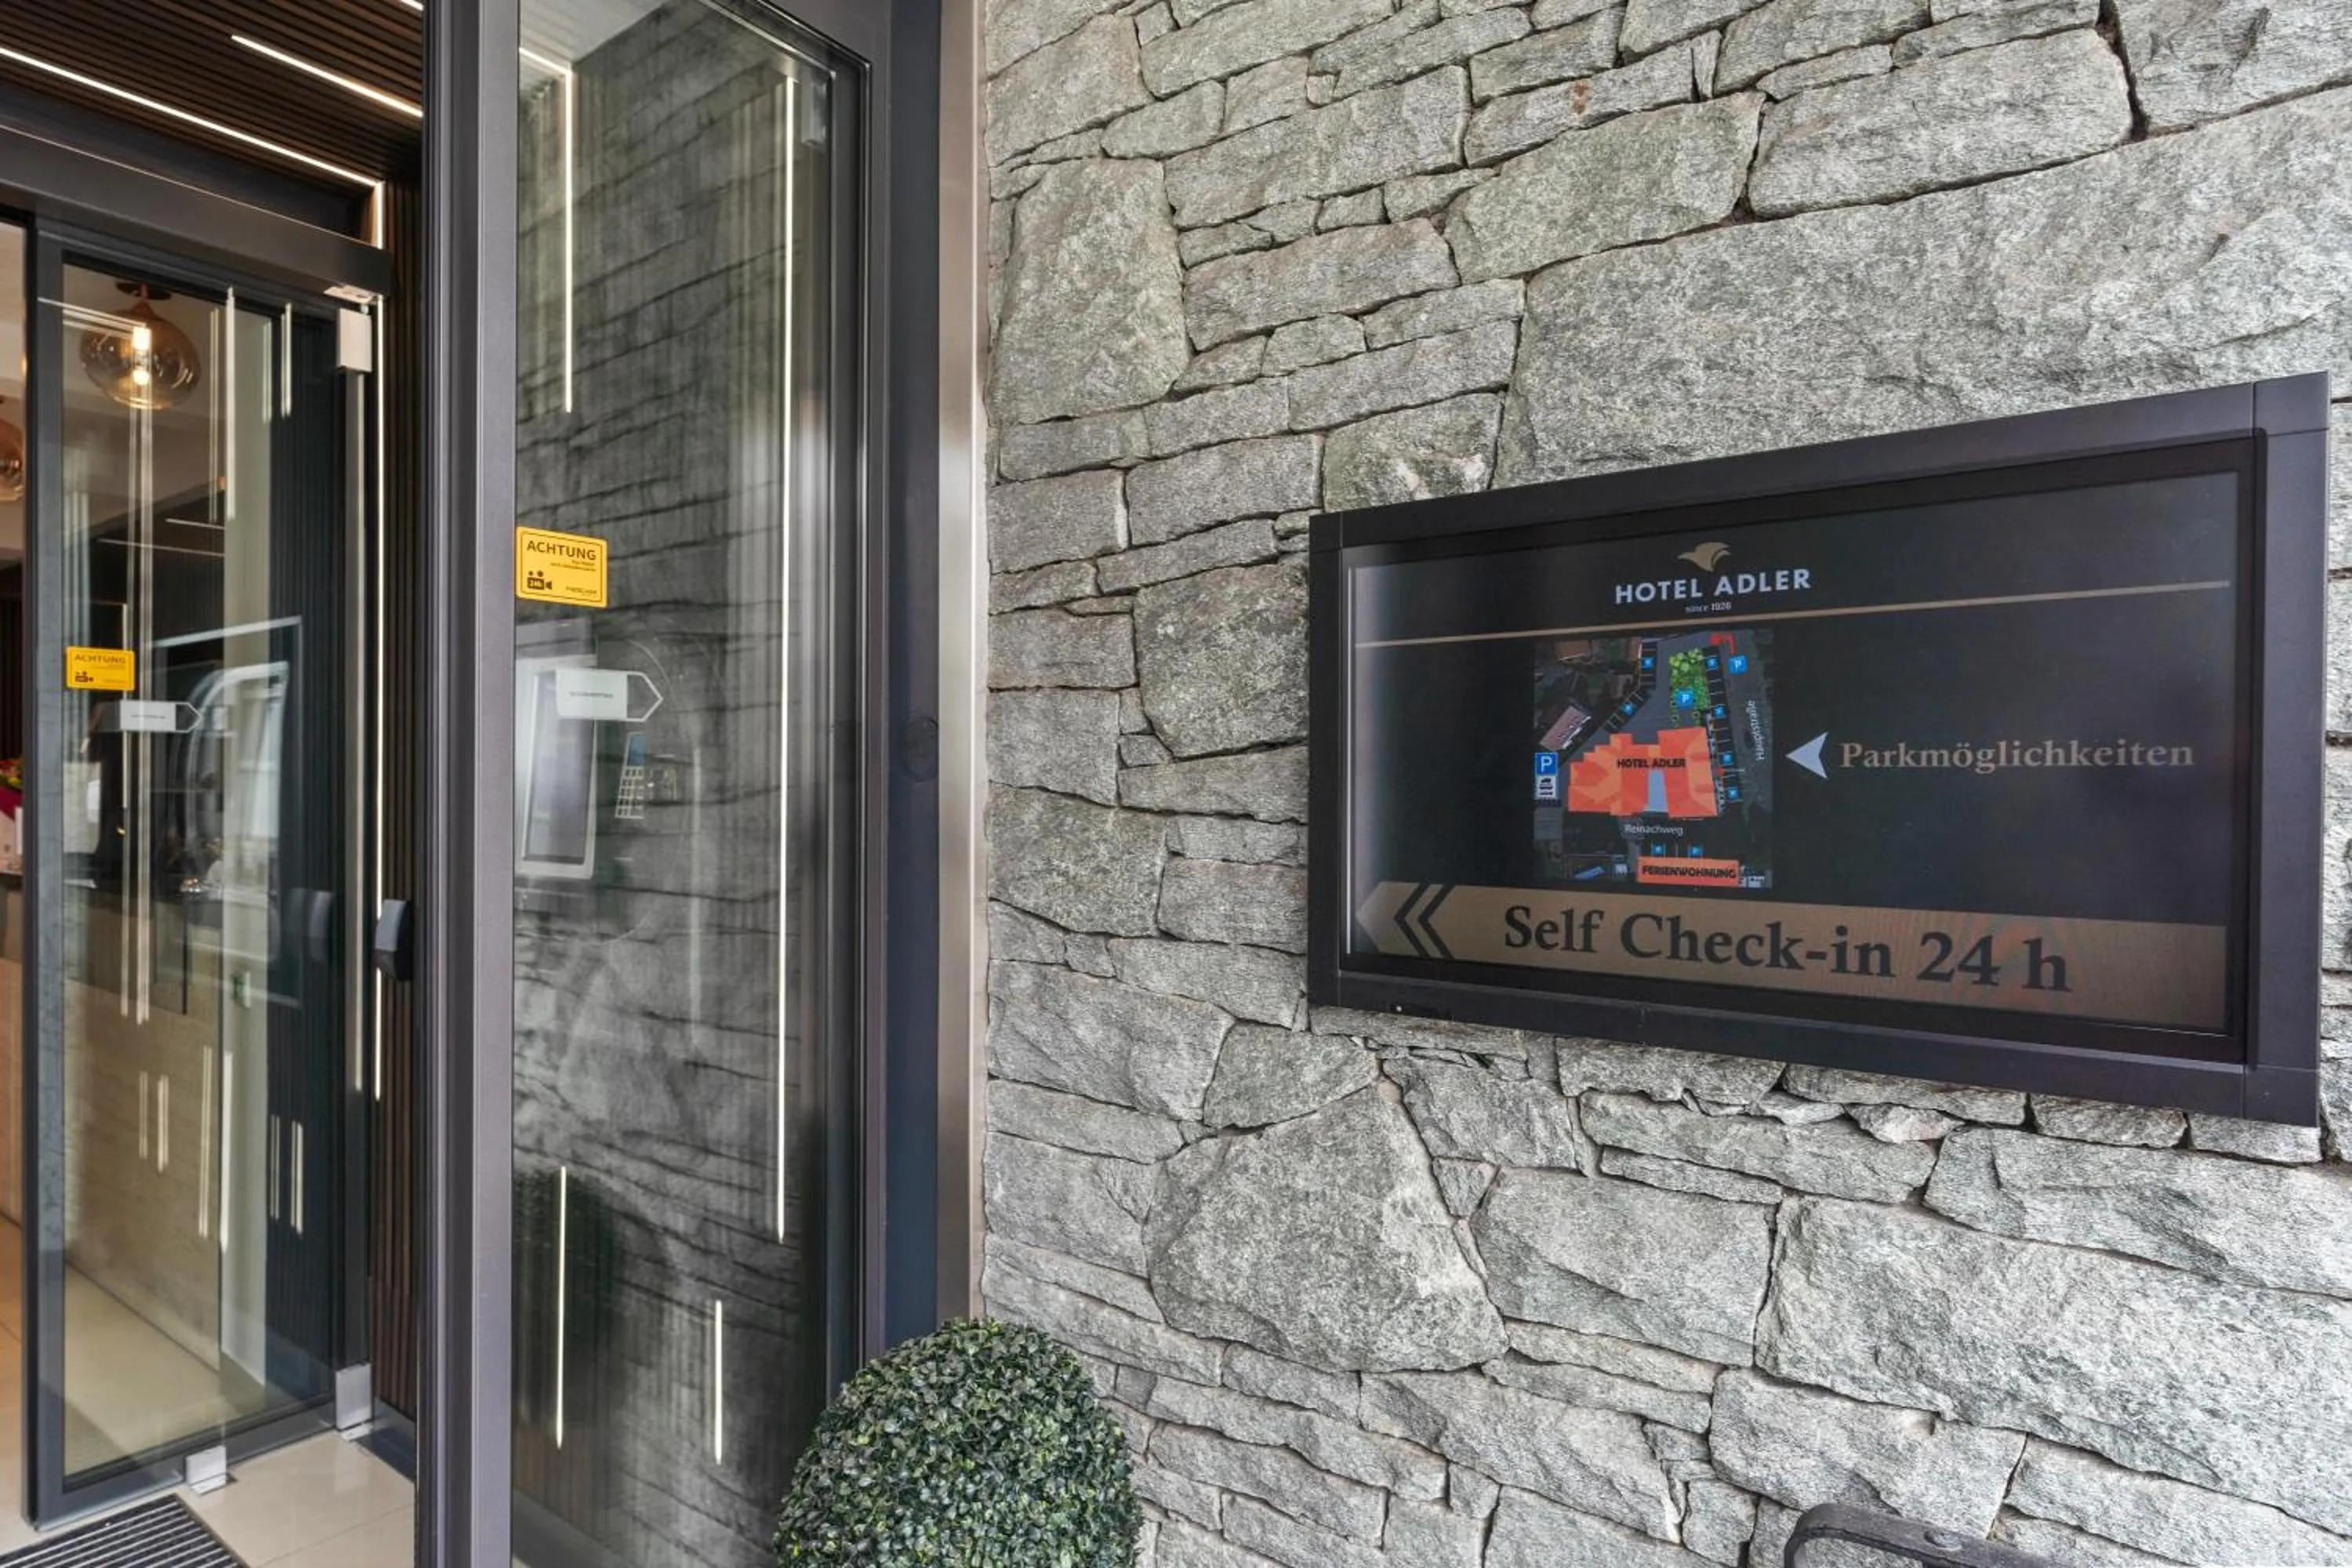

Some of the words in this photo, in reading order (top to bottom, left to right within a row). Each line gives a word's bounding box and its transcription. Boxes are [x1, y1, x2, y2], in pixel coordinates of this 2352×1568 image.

[526, 540, 597, 561] ACHTUNG
[1615, 579, 1703, 604] HOTEL
[1714, 568, 1811, 596] ADLER
[1685, 604, 1709, 613] since
[74, 652, 126, 664] ACHTUNG
[1541, 755, 1553, 772] P
[1616, 758, 1650, 768] HOTEL
[1652, 758, 1686, 768] ADLER
[1839, 739, 2194, 775] Parkmöglichkeiten
[1624, 823, 1683, 836] Reinachweg
[1642, 865, 1737, 878] FERIENWOHNUNG
[1504, 905, 1604, 953] Self
[1620, 913, 1896, 978] Check-in
[1917, 931, 2002, 985] 24
[2022, 937, 2073, 992] h
